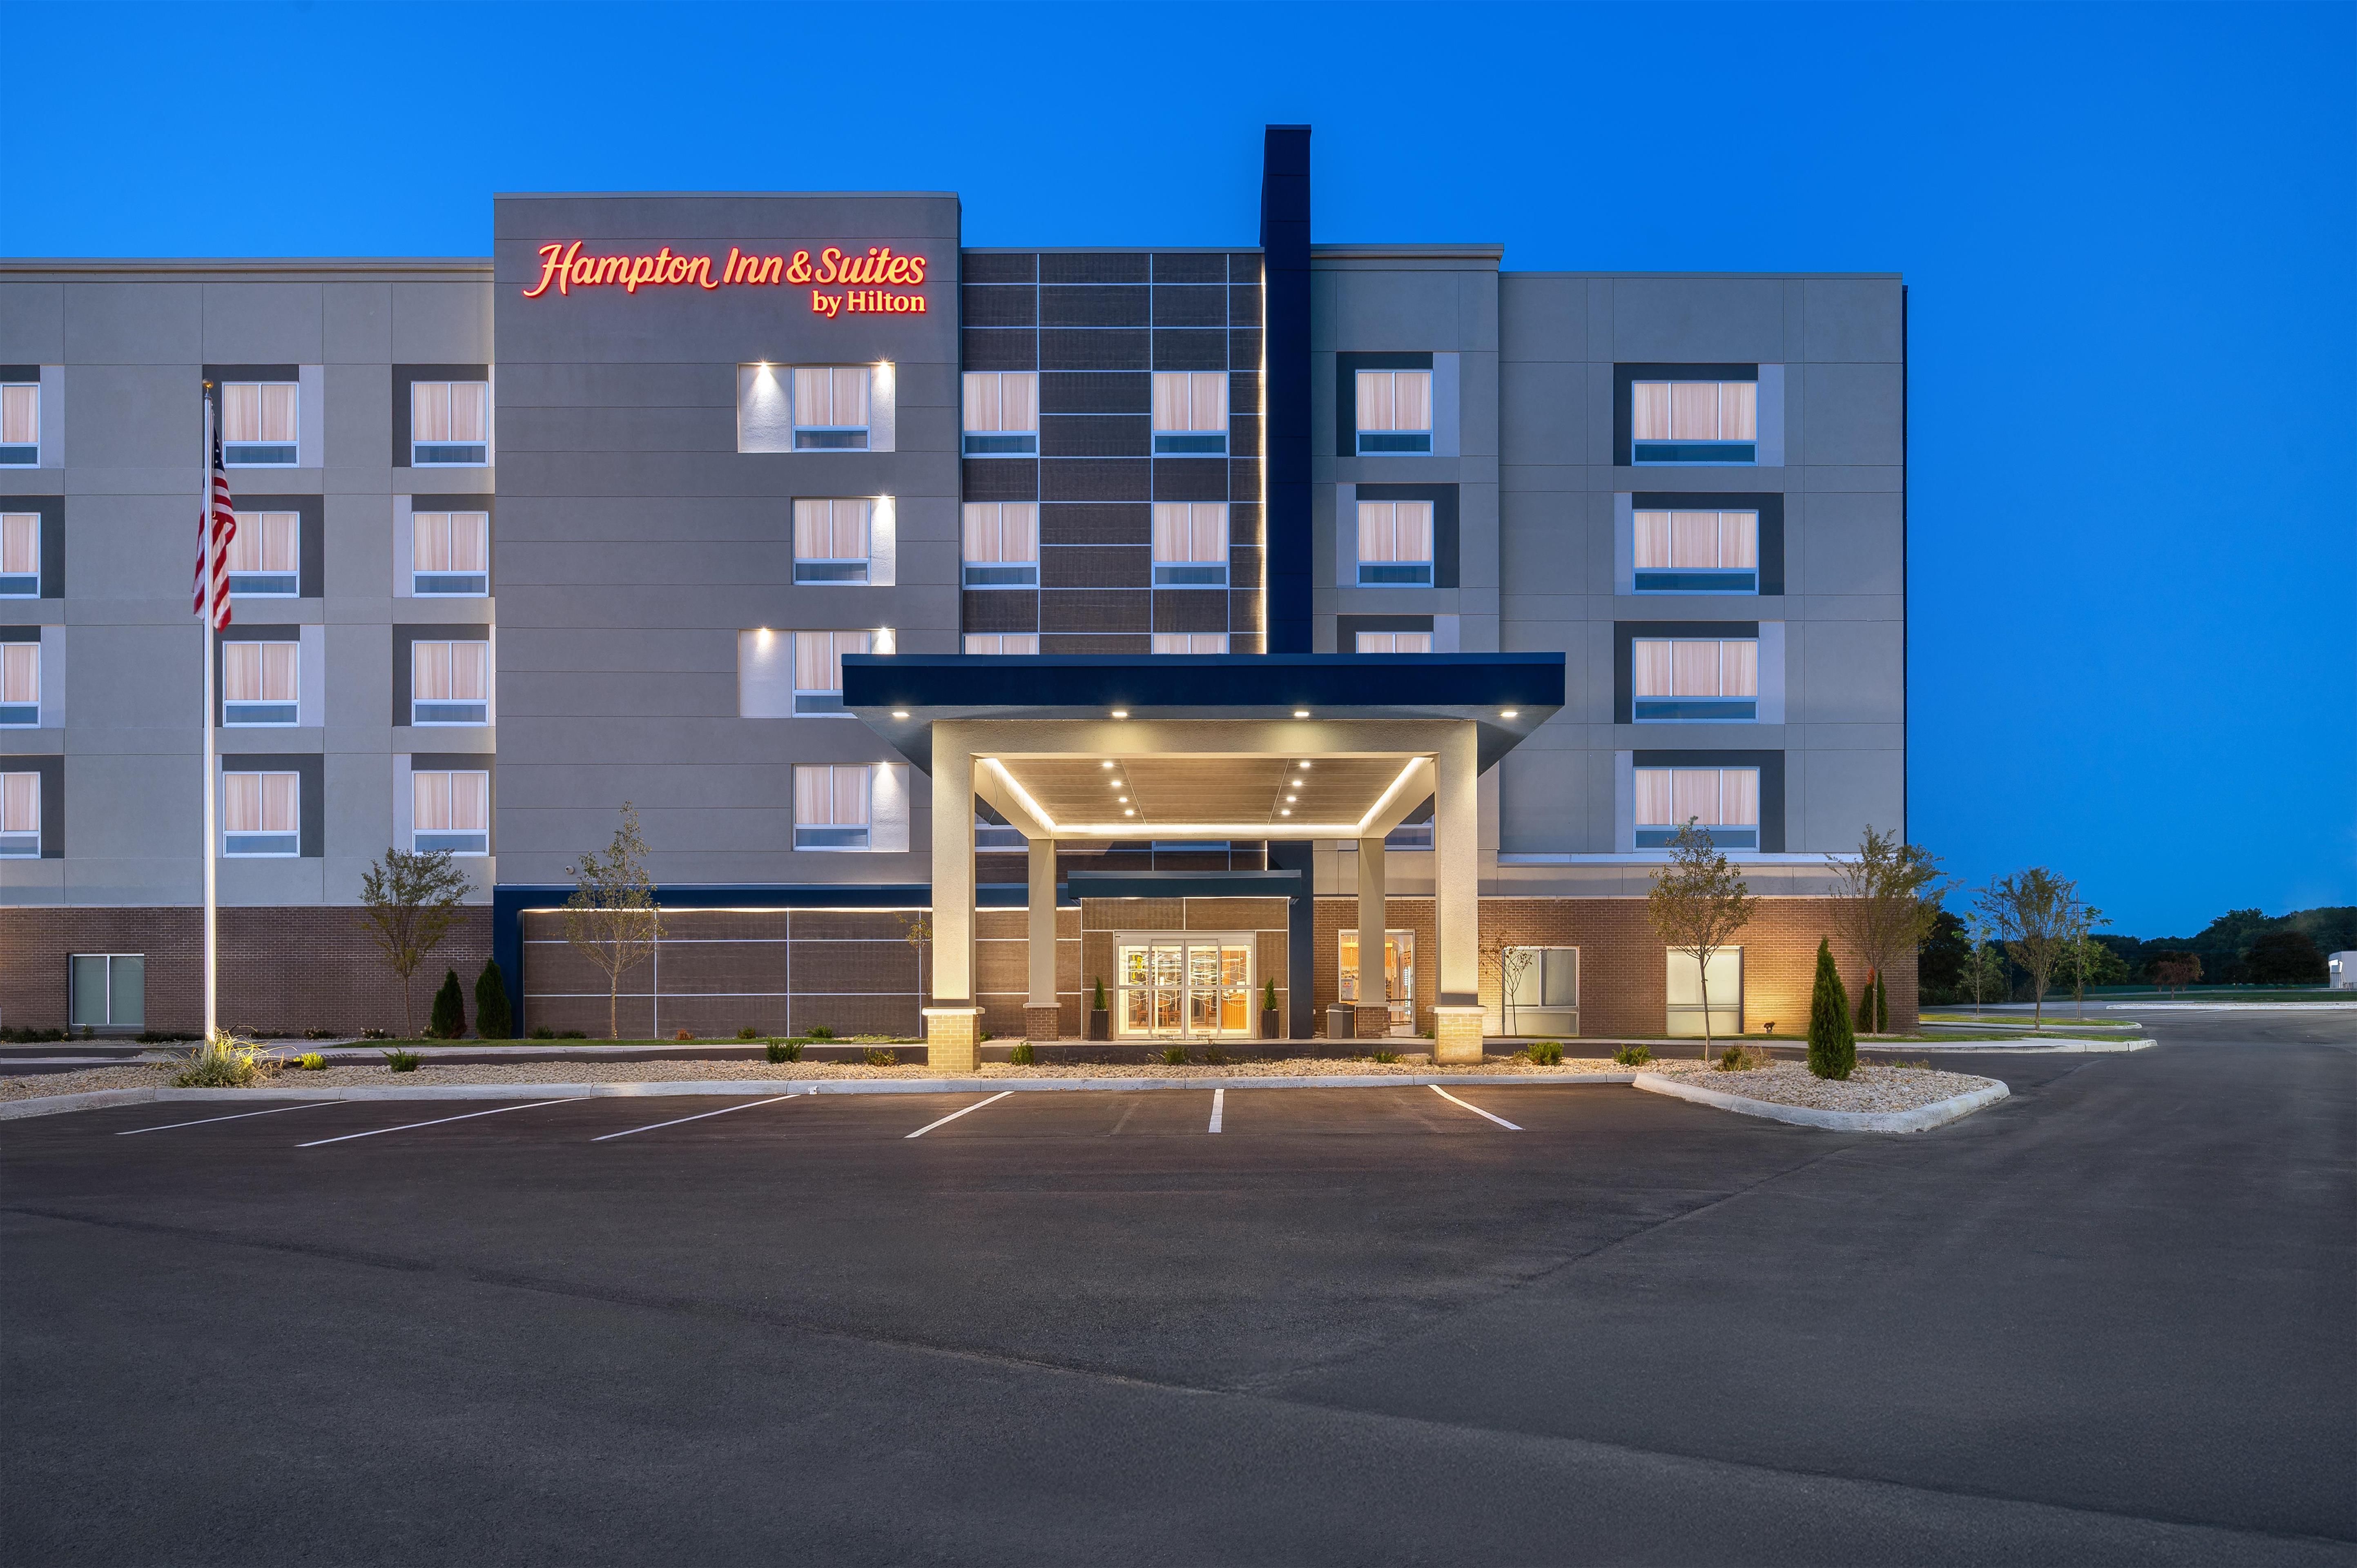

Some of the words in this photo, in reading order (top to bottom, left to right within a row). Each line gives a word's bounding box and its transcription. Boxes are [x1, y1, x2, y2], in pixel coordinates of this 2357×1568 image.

[522, 240, 718, 297] Hampton
[722, 247, 783, 285] Inn
[785, 250, 812, 284] &
[814, 247, 926, 285] Suites
[811, 290, 843, 318] by
[846, 290, 926, 313] Hilton
